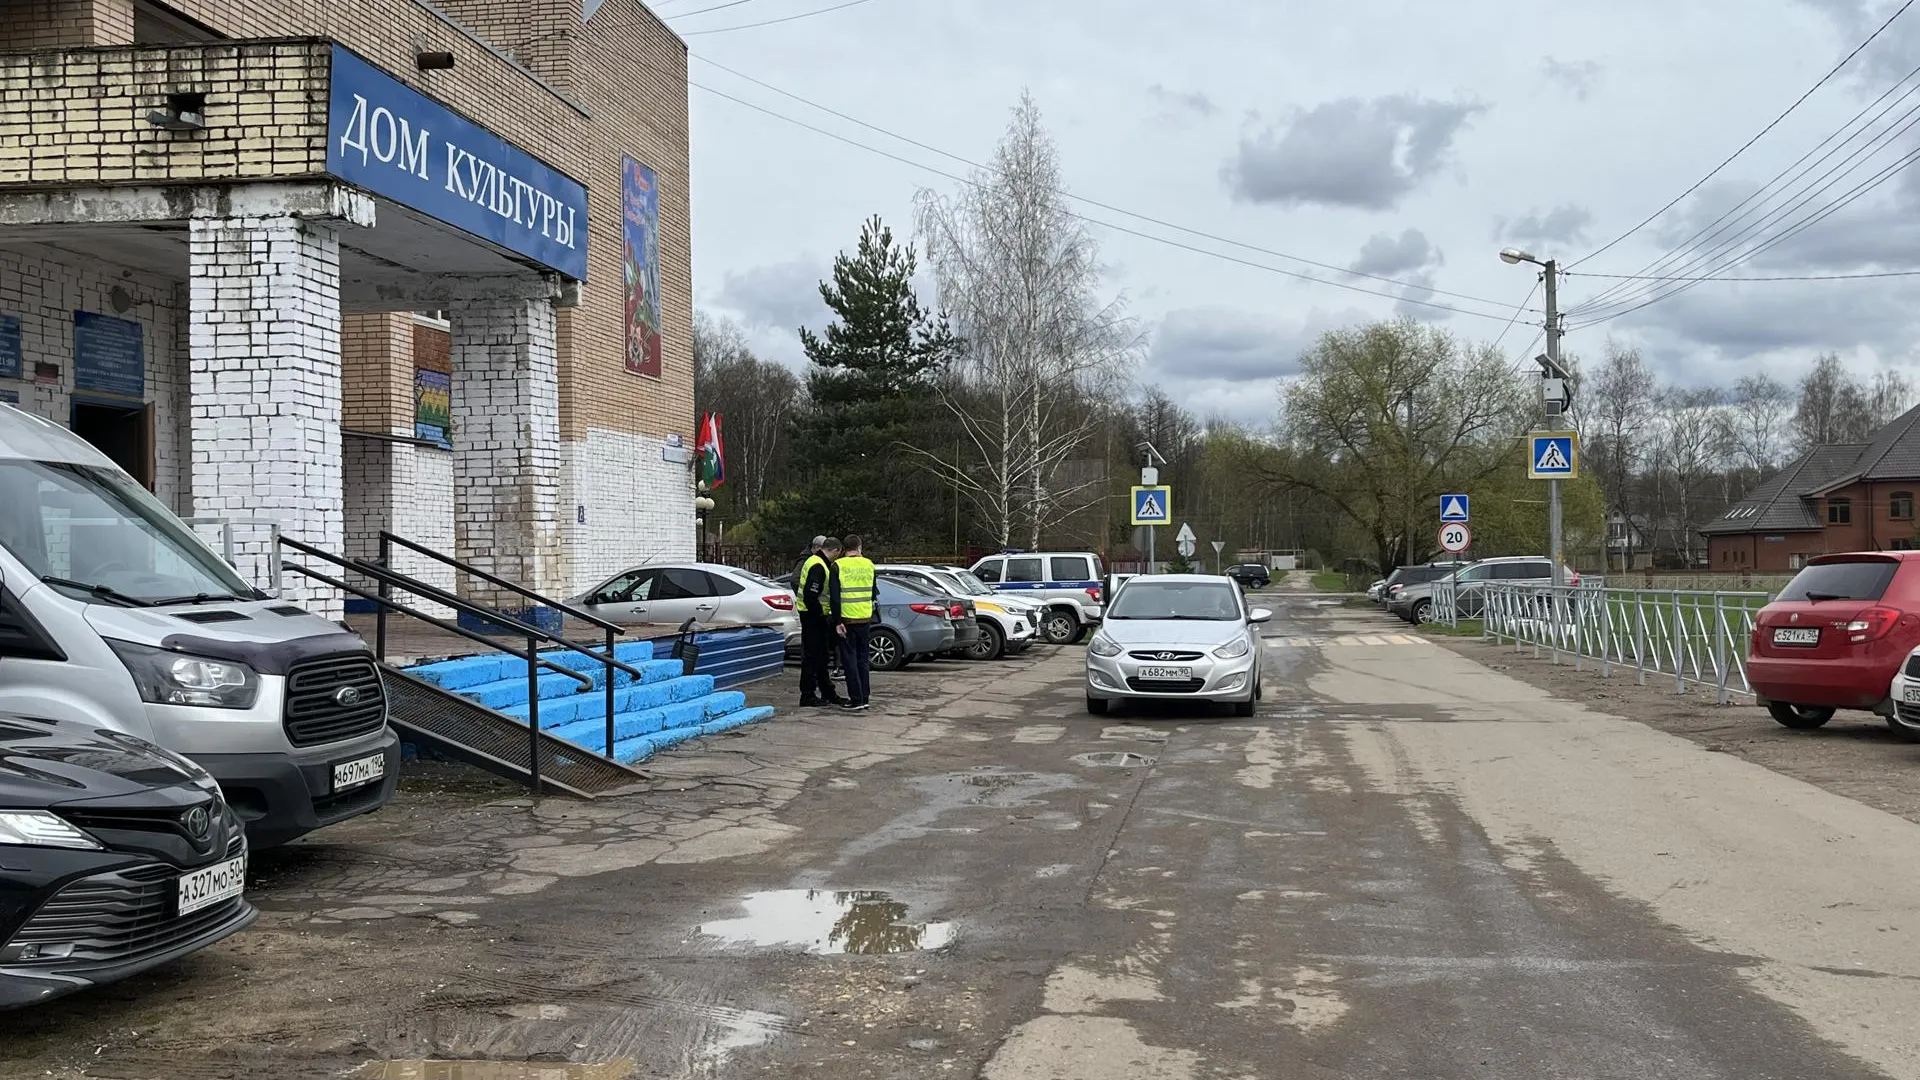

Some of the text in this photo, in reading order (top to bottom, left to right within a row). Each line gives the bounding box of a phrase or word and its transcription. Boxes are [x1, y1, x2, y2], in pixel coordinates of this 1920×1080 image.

[340, 93, 430, 181] ДОМ
[445, 141, 576, 250] КУЛЬТУРЫ
[1446, 531, 1463, 544] 20
